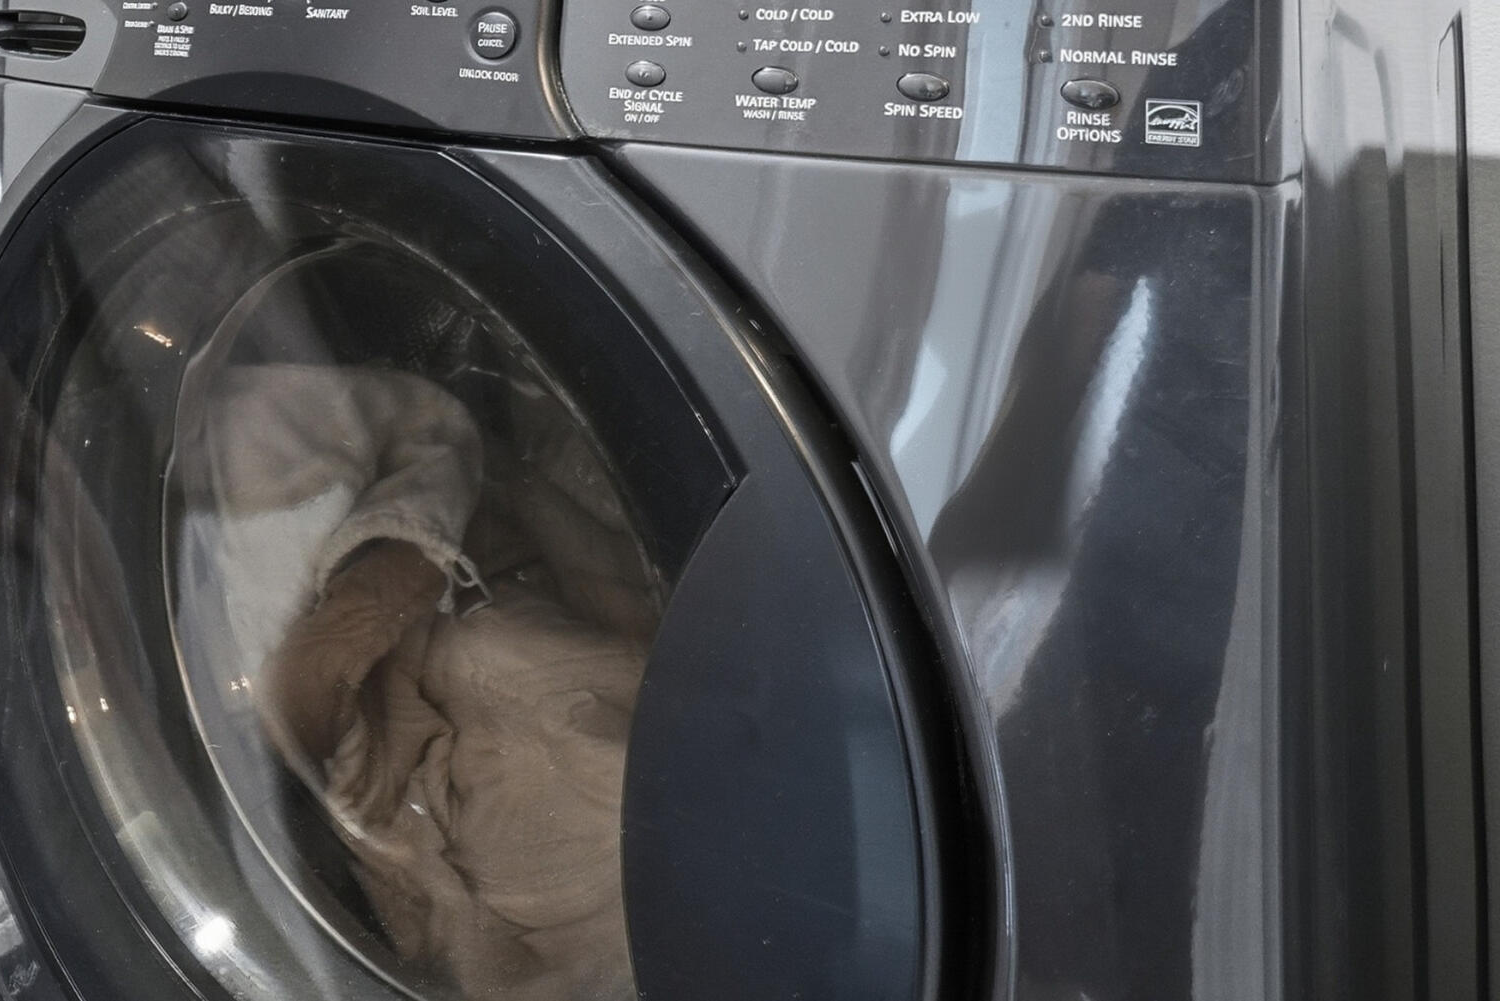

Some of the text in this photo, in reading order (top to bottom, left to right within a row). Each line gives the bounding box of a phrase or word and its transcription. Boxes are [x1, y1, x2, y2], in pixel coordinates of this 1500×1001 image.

[305, 6, 349, 19] SANITARY
[410, 5, 459, 18] SOIL LEVEL
[755, 8, 788, 21] COLD
[800, 8, 834, 21] COLD
[900, 10, 981, 24] EXTRA LOW
[1061, 13, 1143, 28] 2ND RINSE
[478, 22, 508, 34] PAUSE
[608, 33, 693, 47] EXTENDED SPIN
[753, 38, 778, 51] TAP
[779, 39, 813, 53] COLD
[825, 40, 860, 53] COLD
[898, 44, 957, 58] NO SPIN
[1060, 49, 1178, 66] NORMAL RINSE
[459, 68, 519, 82] UNLOCK DOOR
[609, 87, 684, 102] END of CYCLE
[624, 100, 665, 113] SIGNAL
[735, 95, 817, 110] WATER TEMP
[624, 112, 638, 122] ON
[644, 114, 660, 123] OFF
[743, 109, 771, 120] WASH
[778, 111, 805, 121] RINSE
[883, 102, 963, 120] SPIN SPEED
[1067, 111, 1111, 127] RINSE
[1056, 127, 1123, 144] OPTIONS
